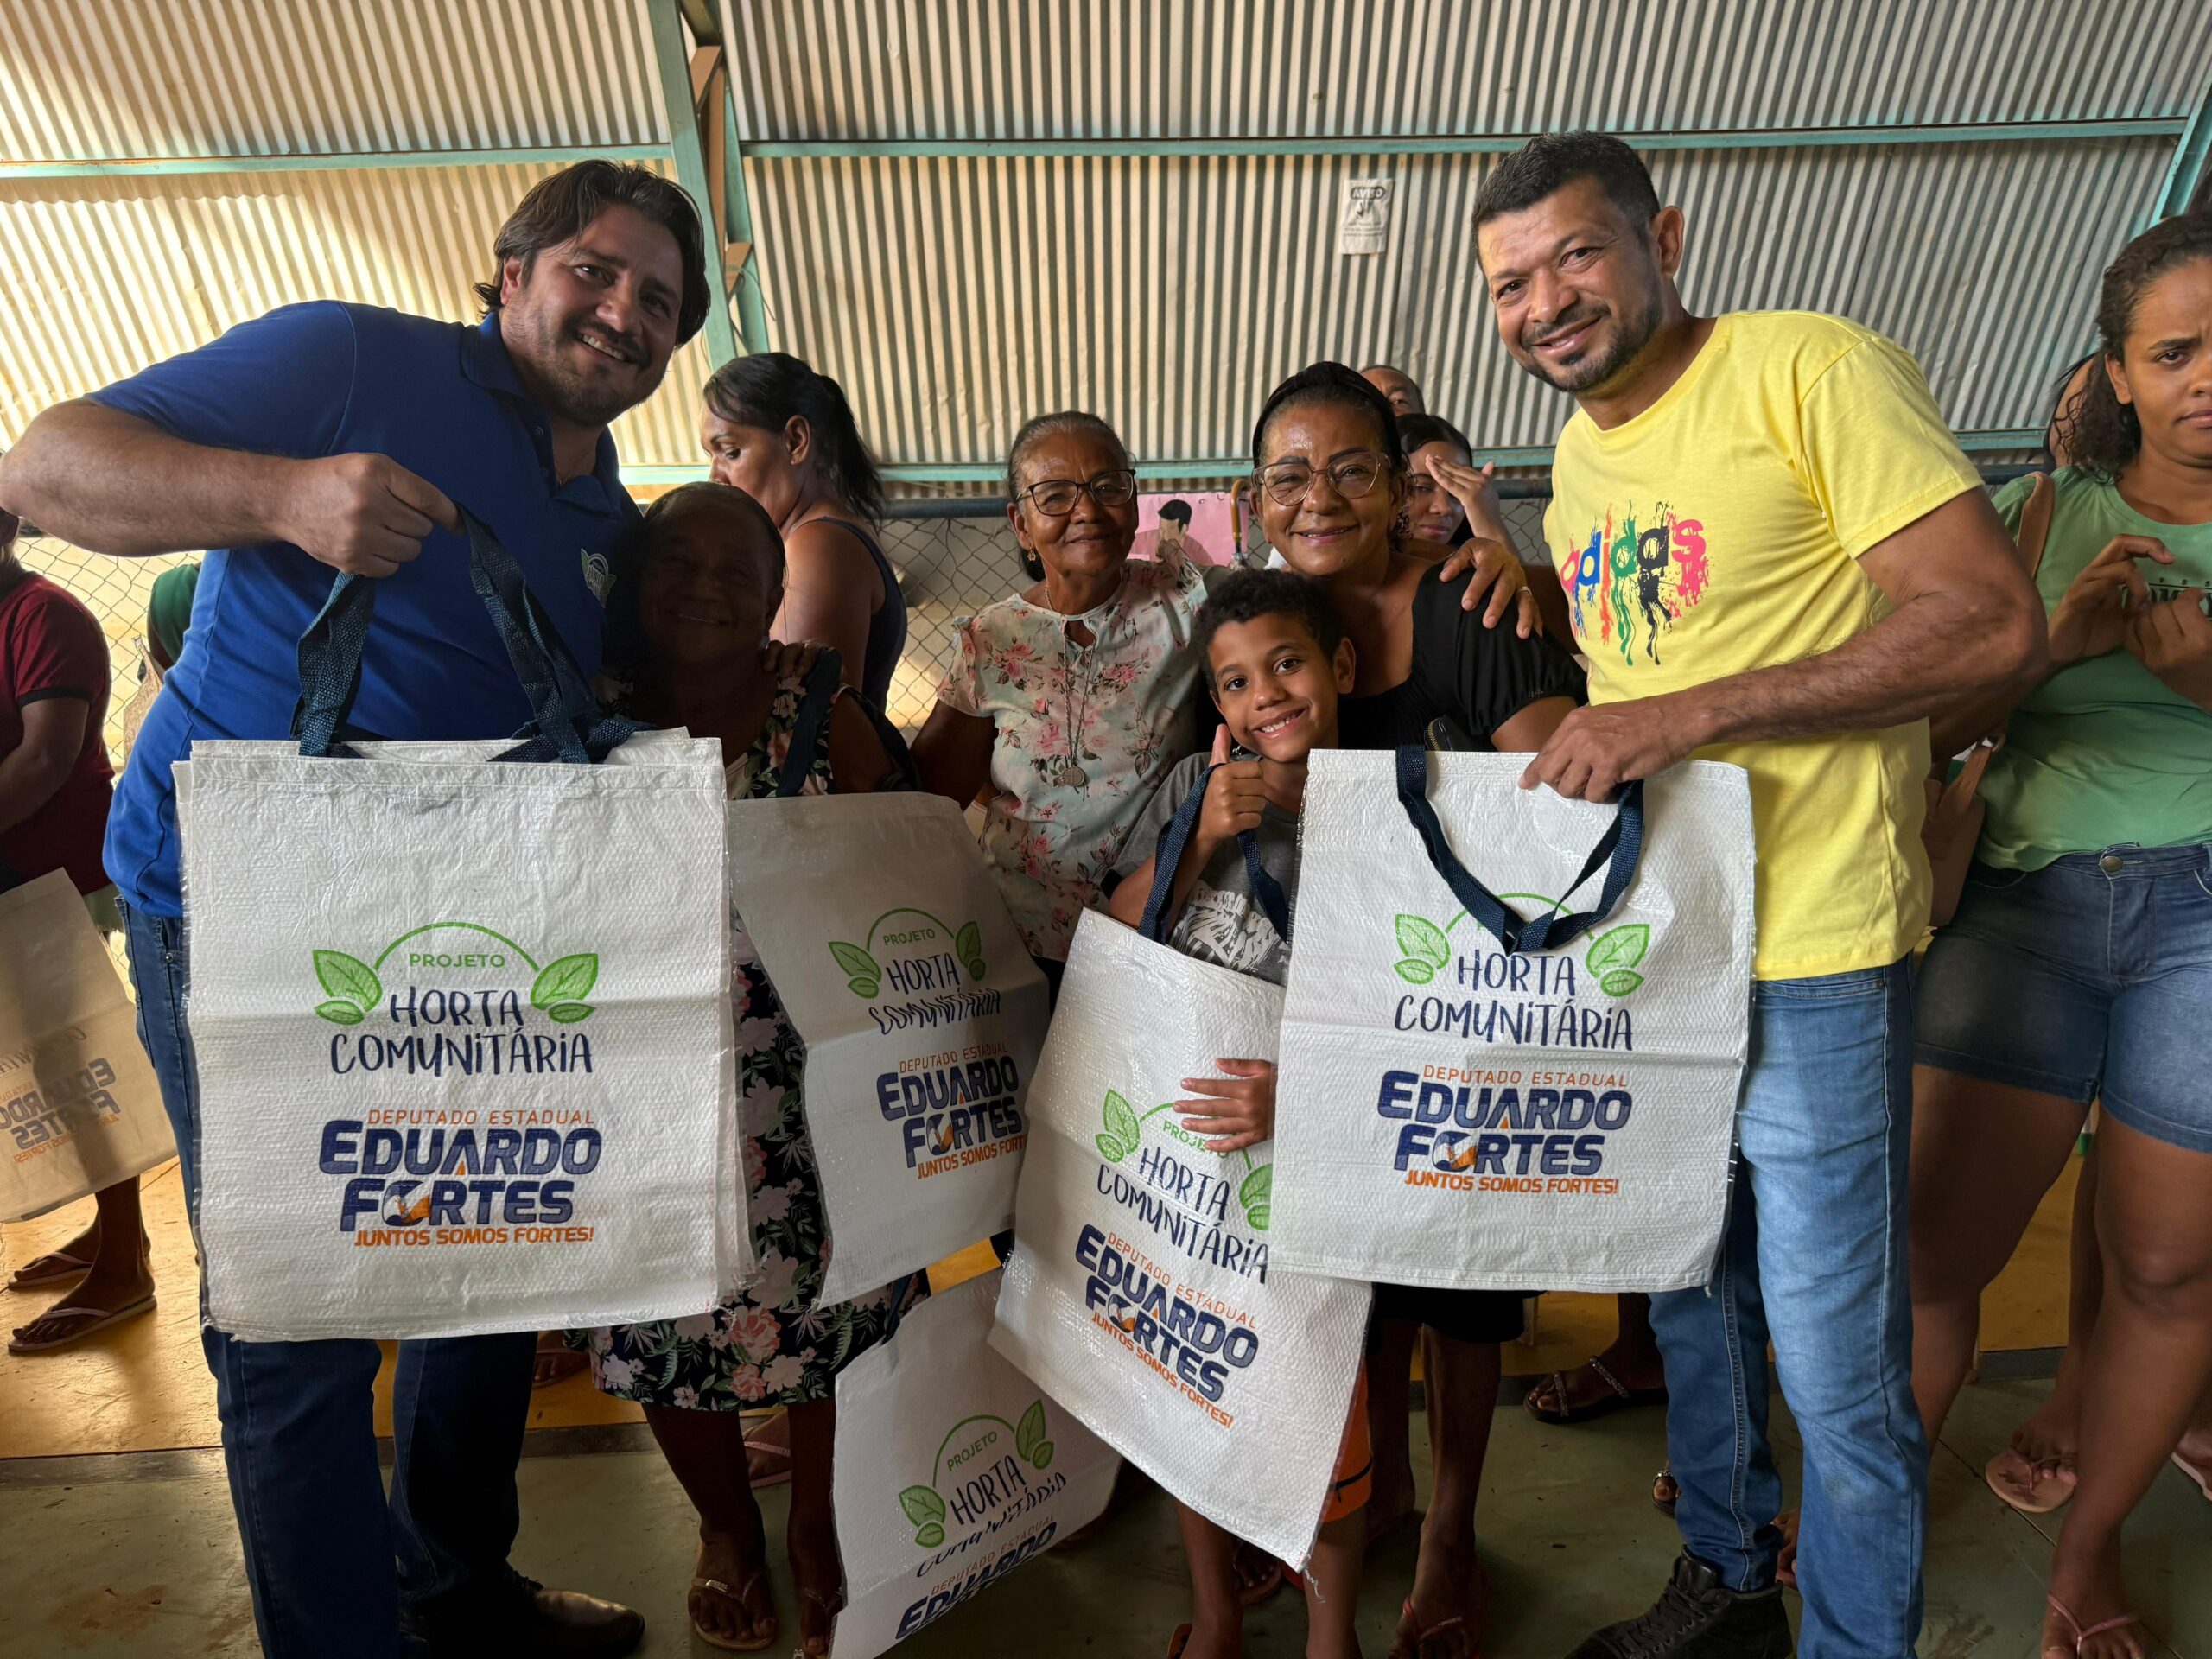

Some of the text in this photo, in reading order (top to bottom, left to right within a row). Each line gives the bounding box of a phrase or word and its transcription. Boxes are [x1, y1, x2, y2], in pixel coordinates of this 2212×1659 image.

[1560, 512, 1707, 618] adidas
[409, 953, 506, 969] PROJETO
[883, 928, 936, 946] PROJETO
[886, 952, 960, 995] HORTA
[1458, 949, 1576, 996] HORTA
[390, 986, 524, 1027] HORTA
[899, 1042, 1008, 1073] DEPUTADO ESTADUAL
[1423, 1065, 1627, 1087] DEPUTADO ESTADUAL
[876, 1055, 1020, 1122] EDUARDO
[1377, 1070, 1633, 1131] EDUARDO
[368, 1109, 594, 1125] DEPUTADO ESTADUAL
[903, 1096, 1023, 1168] FORTES
[319, 1120, 602, 1175] EDUARDO
[918, 1135, 1027, 1179] JUNTOS SOMOS FORT
[1393, 1123, 1605, 1176] FORTES
[340, 1178, 575, 1232] FORTES
[1137, 1147, 1230, 1221] HORTA
[1404, 1169, 1619, 1194] JUNTOS SOMOS FORTES!
[354, 1226, 594, 1247] JUNTOS SOMOS FORTES!
[1075, 1224, 1259, 1368] EDUARDO
[1108, 1231, 1256, 1329] DEPUTADO ESTADUAL
[1085, 1275, 1230, 1402] FORTES
[1091, 1312, 1234, 1429] JUNTOS SOMOS FORTES!
[947, 1431, 997, 1471] PROJETO
[950, 1454, 1027, 1525] HORTA
[931, 1514, 1055, 1596] DEPUTADO ESTADUAL
